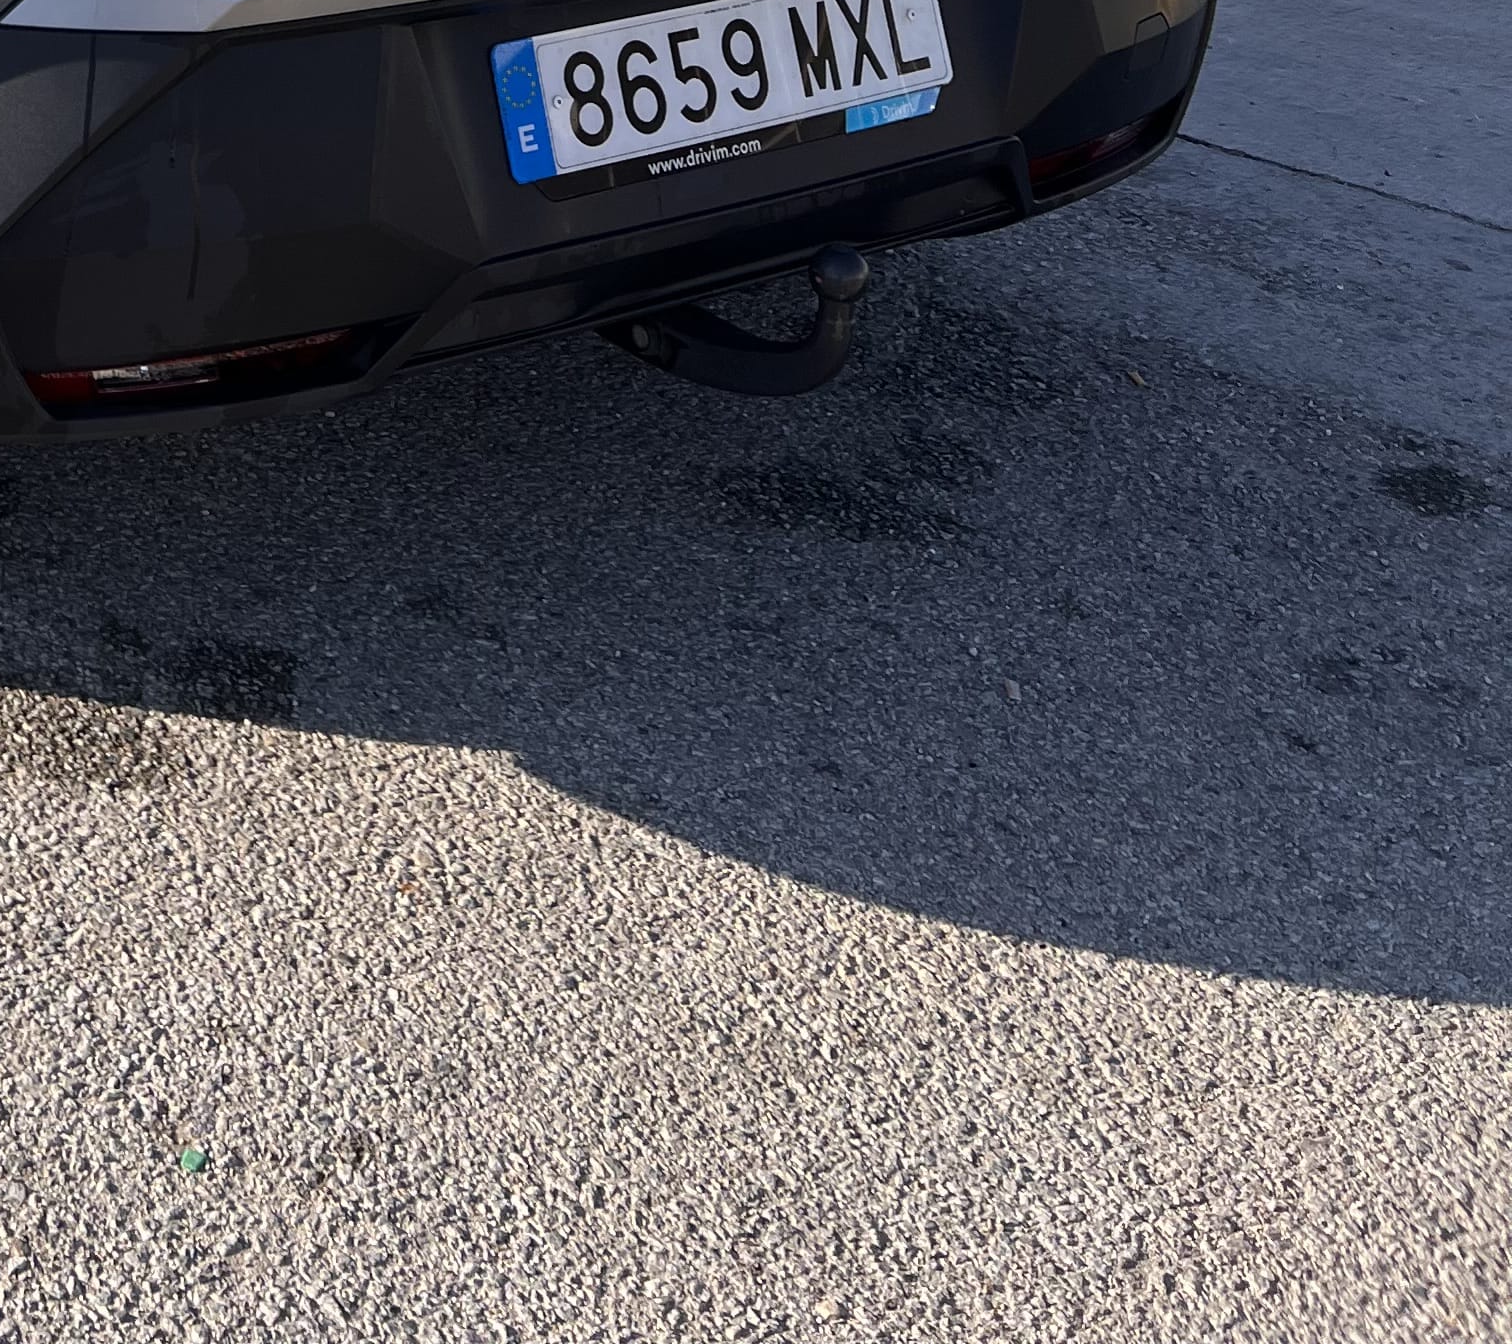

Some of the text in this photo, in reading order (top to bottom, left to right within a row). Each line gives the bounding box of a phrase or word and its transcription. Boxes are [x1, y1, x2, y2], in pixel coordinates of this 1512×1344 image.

[563, 18, 769, 147] 8659
[518, 123, 539, 153] E
[648, 139, 762, 175] www.drivim.com
